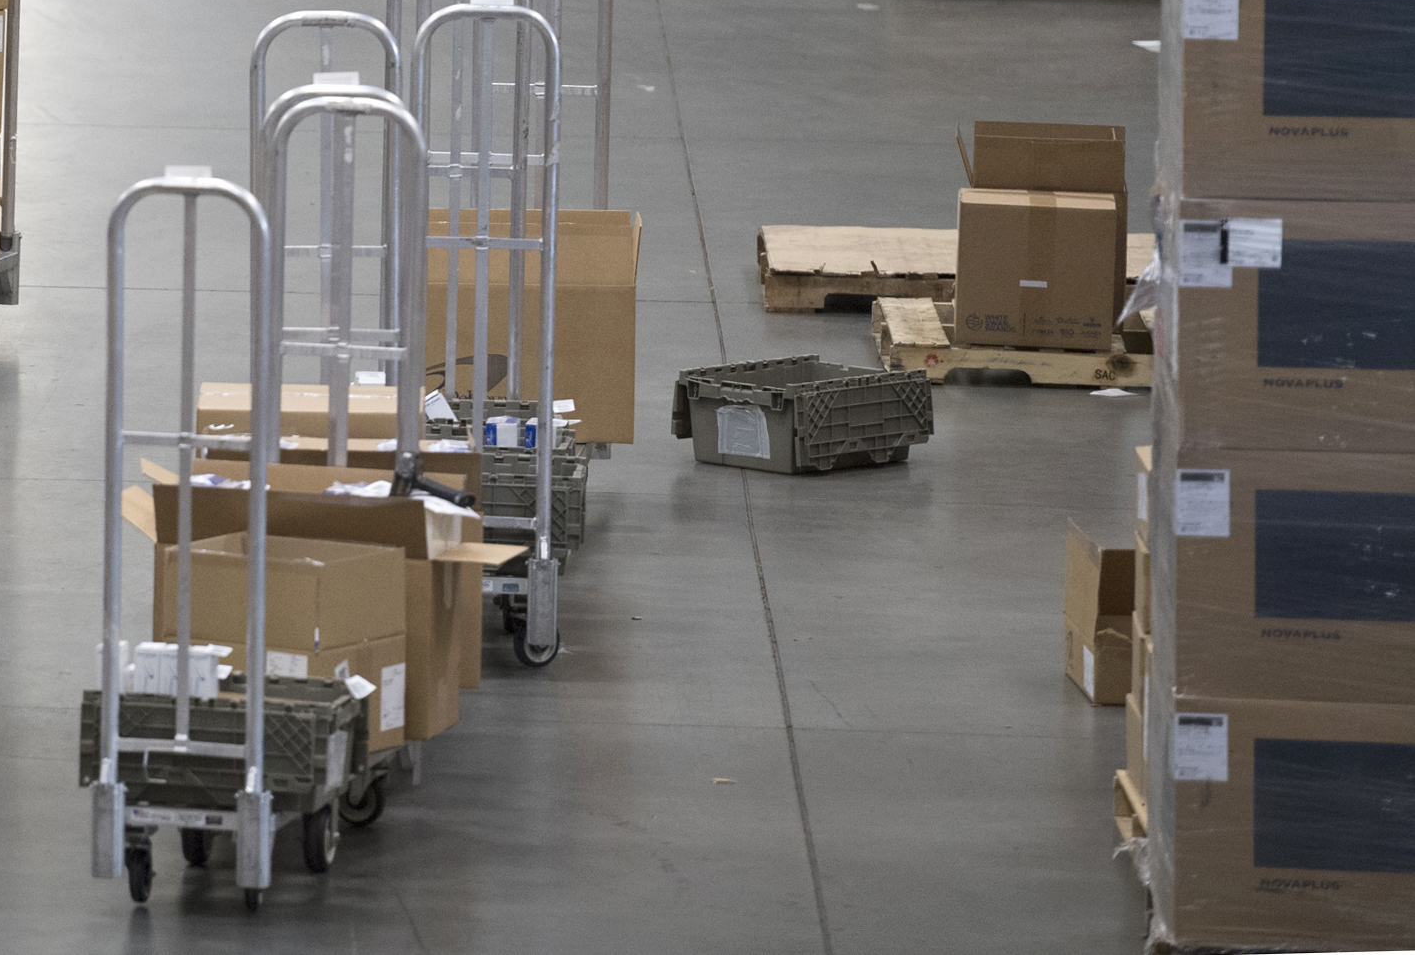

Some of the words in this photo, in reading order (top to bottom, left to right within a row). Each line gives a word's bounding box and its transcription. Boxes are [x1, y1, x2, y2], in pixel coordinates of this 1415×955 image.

[1269, 126, 1349, 137] NOVAPLUS
[1094, 369, 1116, 381] SAC
[1263, 378, 1344, 388] NOVAPLUS
[1261, 629, 1341, 640] NOVAPLUS
